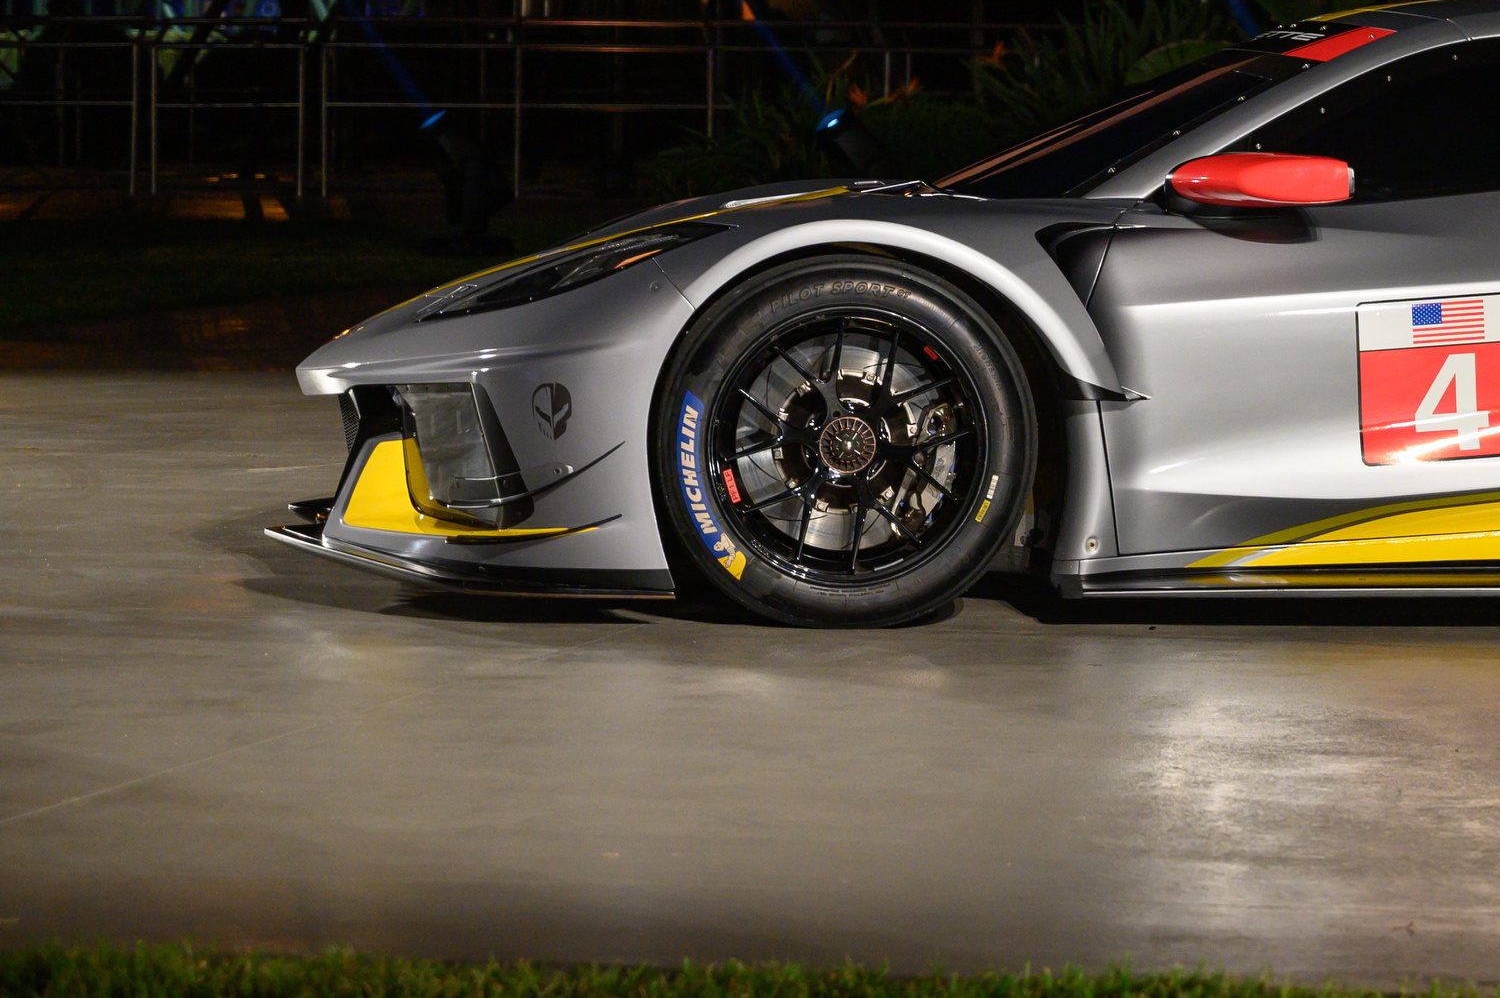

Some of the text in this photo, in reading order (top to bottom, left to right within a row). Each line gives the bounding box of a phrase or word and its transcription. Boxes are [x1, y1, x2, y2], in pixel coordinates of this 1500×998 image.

[770, 283, 825, 314] PILOT
[831, 281, 895, 298] SPORT
[1414, 352, 1490, 451] 4
[680, 405, 718, 534] MICHELIN
